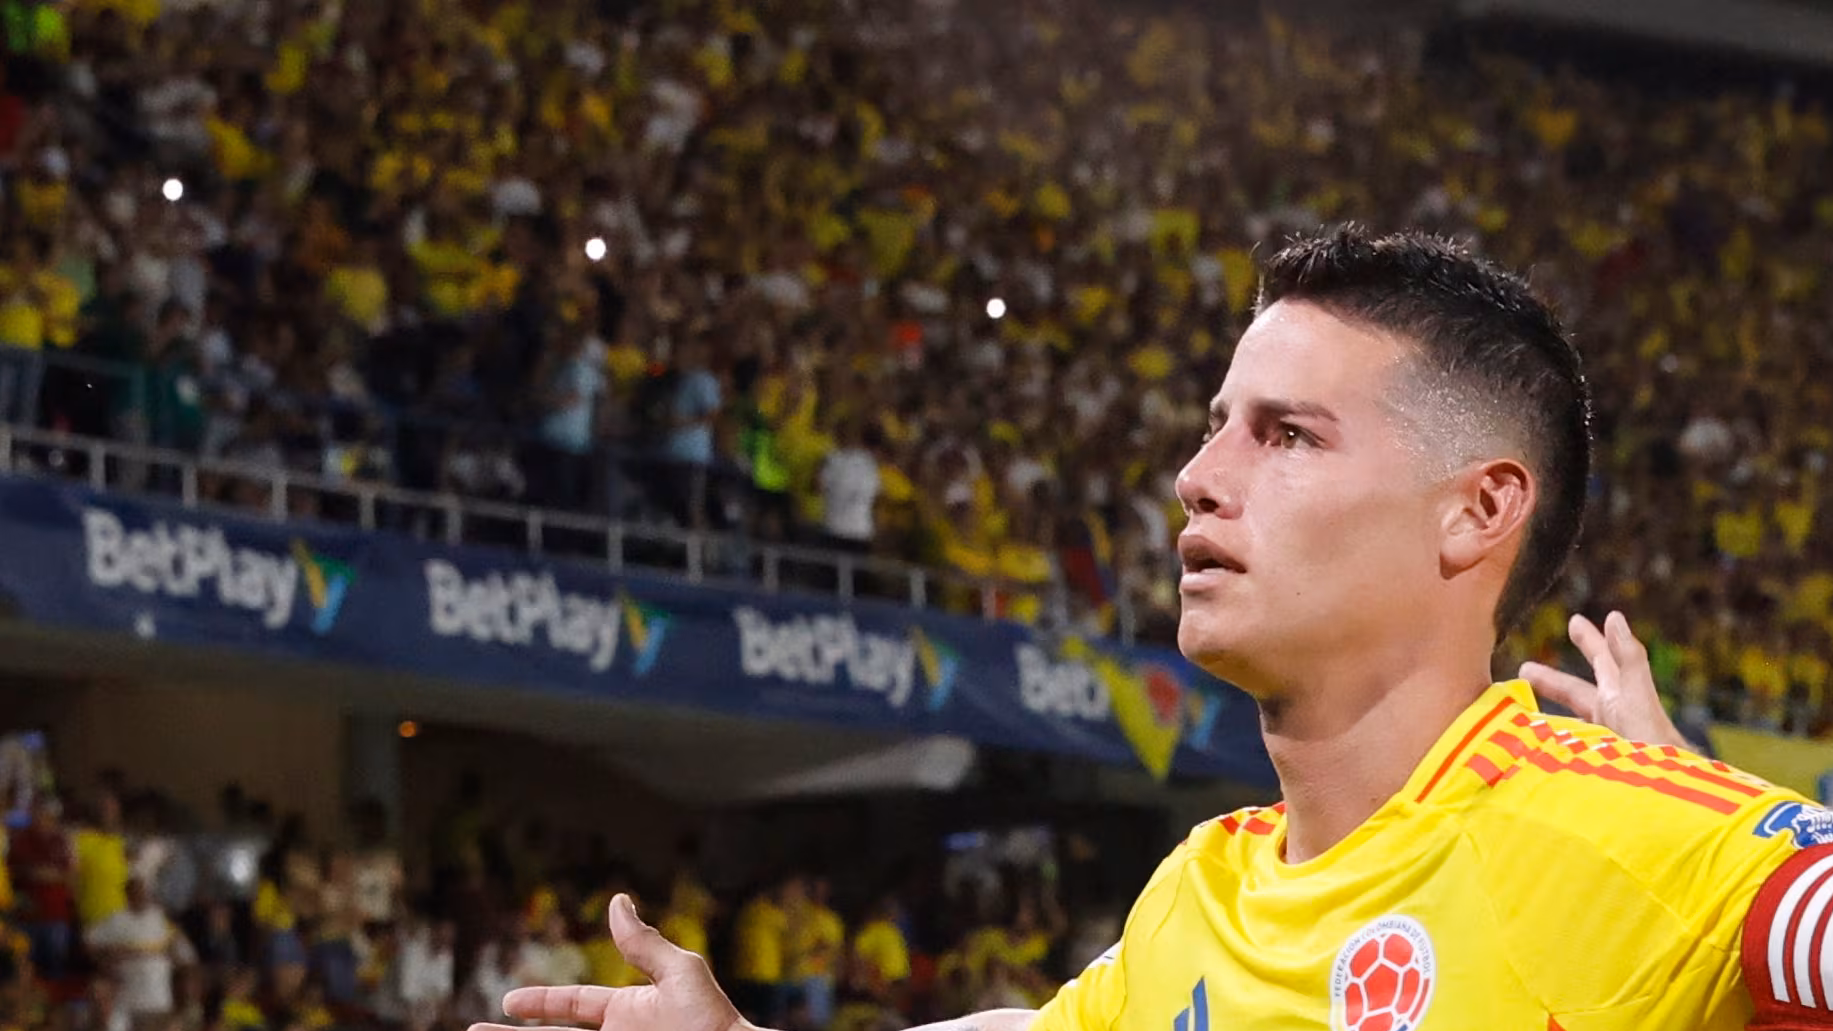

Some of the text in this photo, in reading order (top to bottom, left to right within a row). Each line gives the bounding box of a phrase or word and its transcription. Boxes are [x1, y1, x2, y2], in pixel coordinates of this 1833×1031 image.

[82, 507, 299, 630] BetPlay
[425, 558, 621, 673] BetPlay
[734, 606, 915, 708] BetPlay
